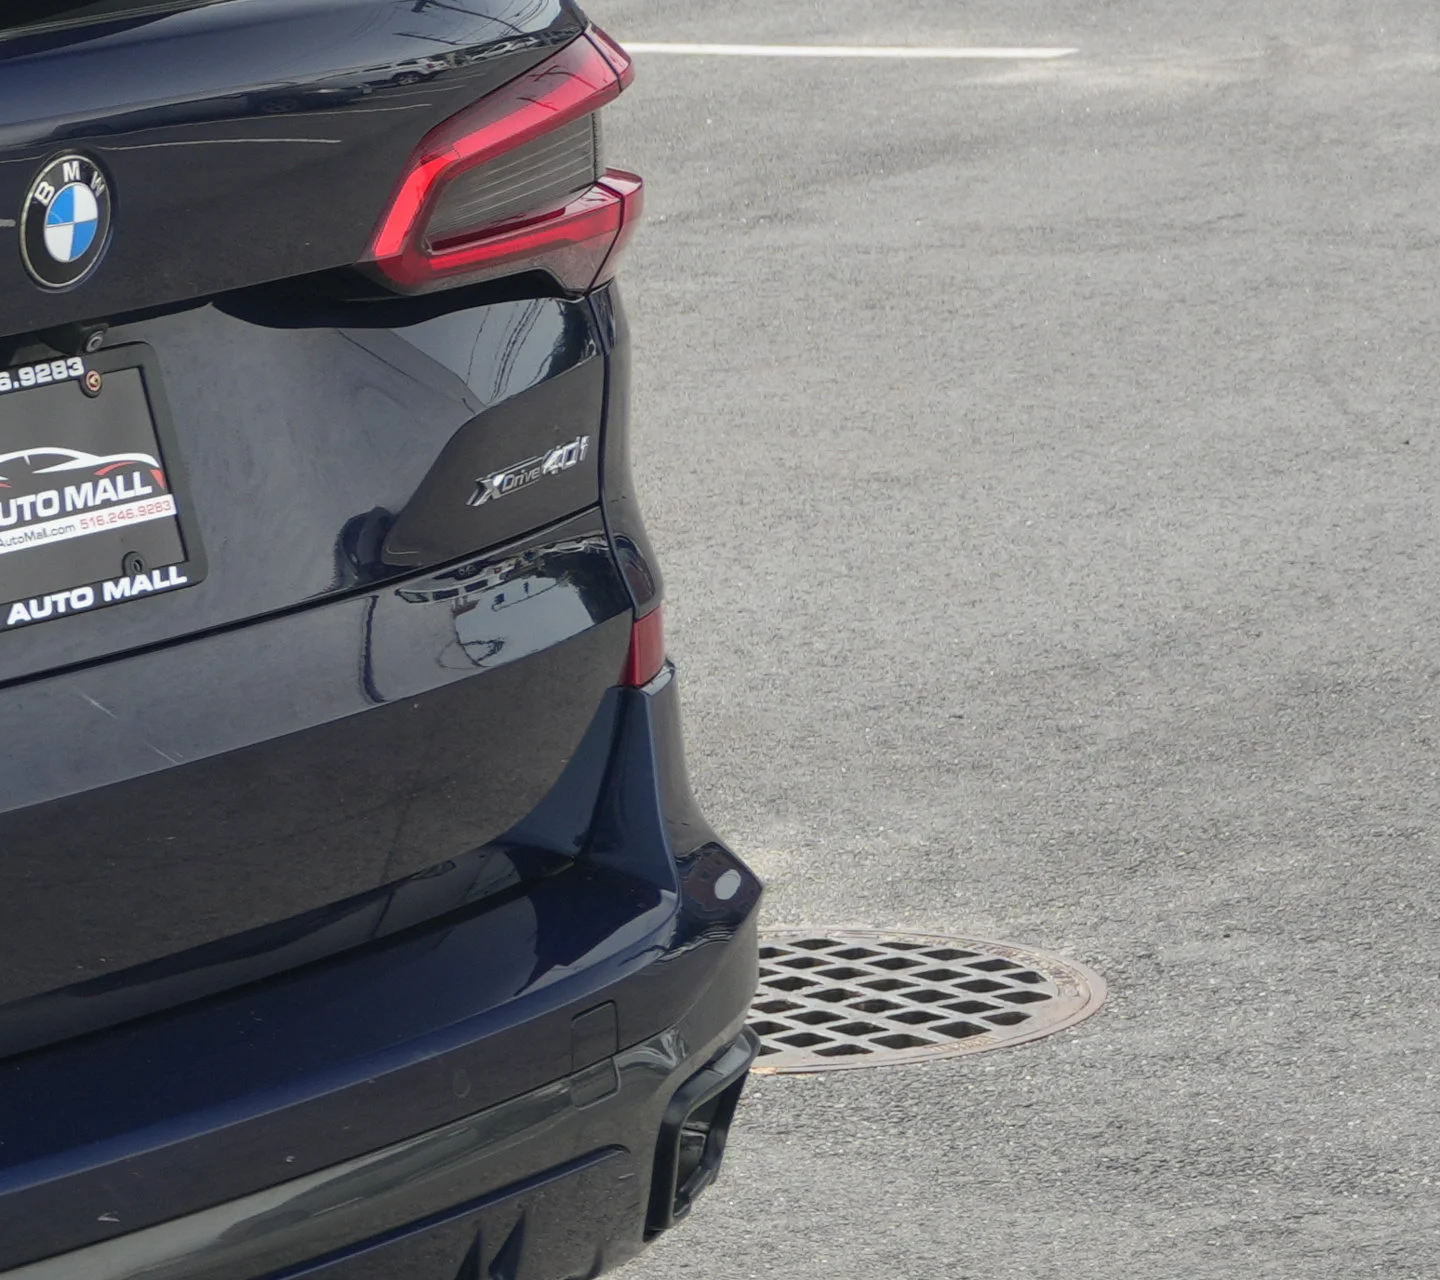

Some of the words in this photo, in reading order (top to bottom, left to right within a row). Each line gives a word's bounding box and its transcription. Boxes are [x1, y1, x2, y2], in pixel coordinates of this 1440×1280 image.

[34, 160, 106, 207] BMW
[67, 471, 153, 512] MALL
[81, 500, 172, 529] 516.246.9283
[7, 586, 94, 625] AUTO
[103, 566, 188, 602] MALL
